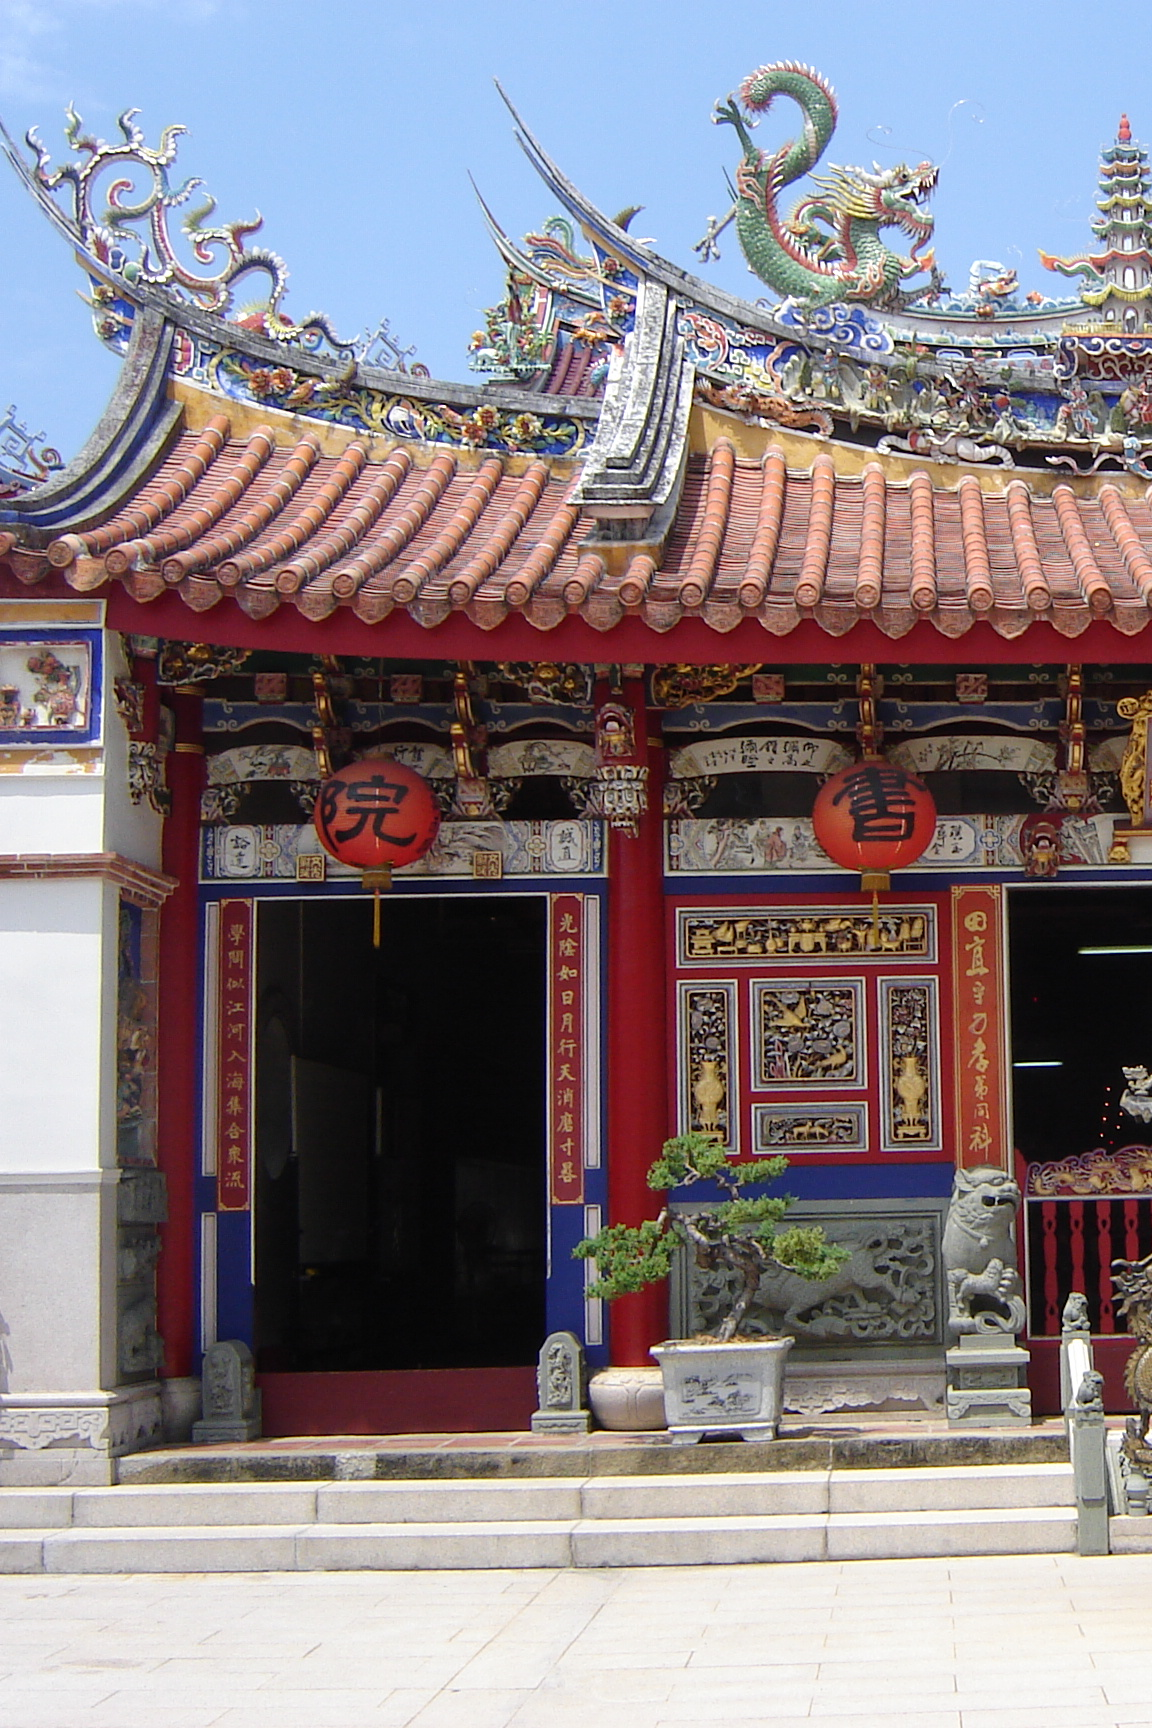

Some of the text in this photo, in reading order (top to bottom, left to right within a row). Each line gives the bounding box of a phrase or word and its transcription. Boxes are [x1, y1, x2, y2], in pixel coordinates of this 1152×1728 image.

[322, 775, 418, 853] 院
[831, 766, 925, 844] 書
[556, 912, 579, 1184] 光陰如日月行天消磨寸晷
